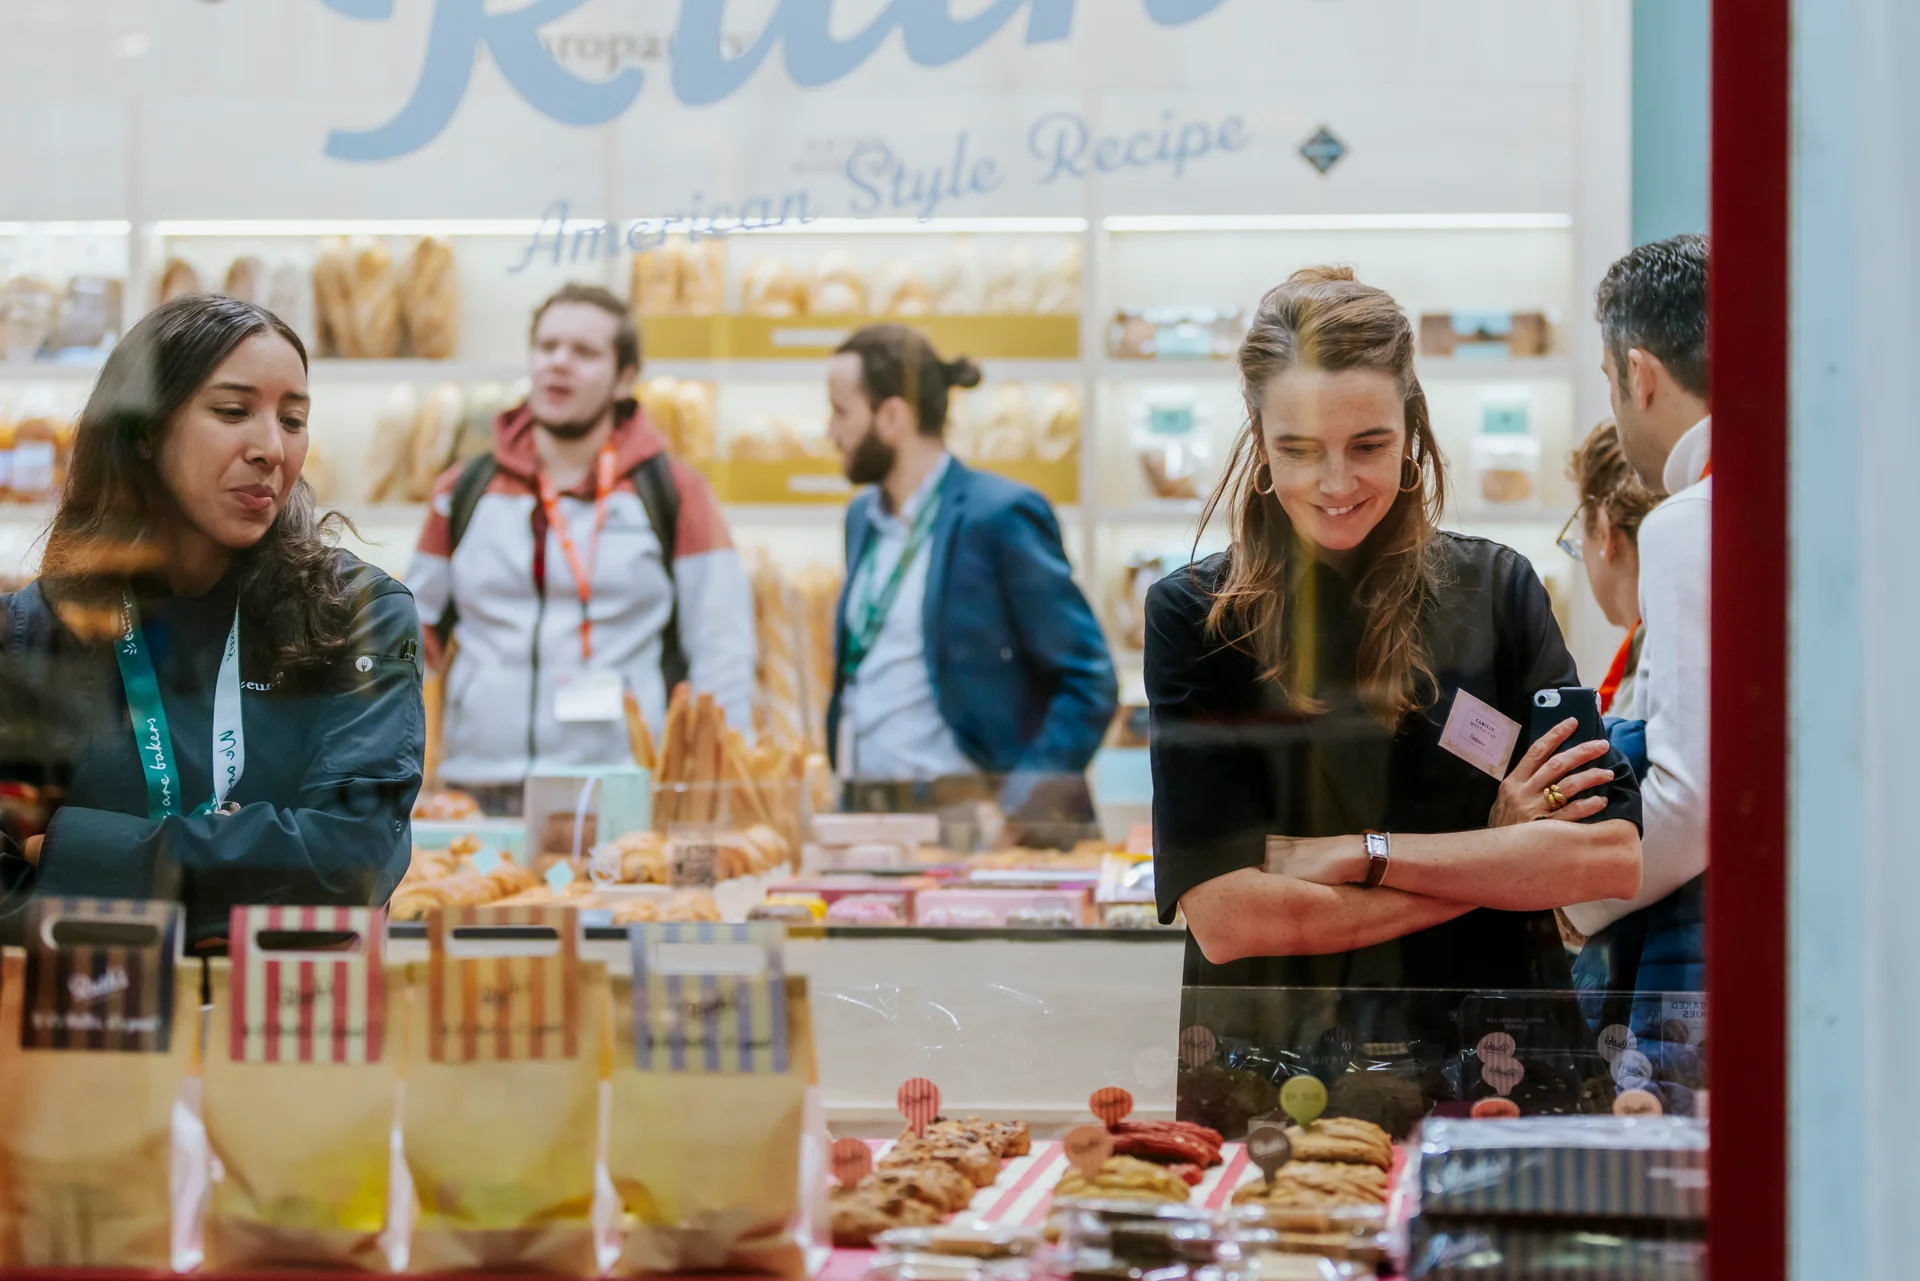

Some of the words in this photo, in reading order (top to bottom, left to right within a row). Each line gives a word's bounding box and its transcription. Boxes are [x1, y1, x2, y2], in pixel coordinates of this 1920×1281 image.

[506, 187, 821, 274] American
[845, 130, 1003, 223] Style
[1027, 111, 1253, 184] Recipe
[145, 717, 167, 770] bakers
[161, 774, 172, 807] are
